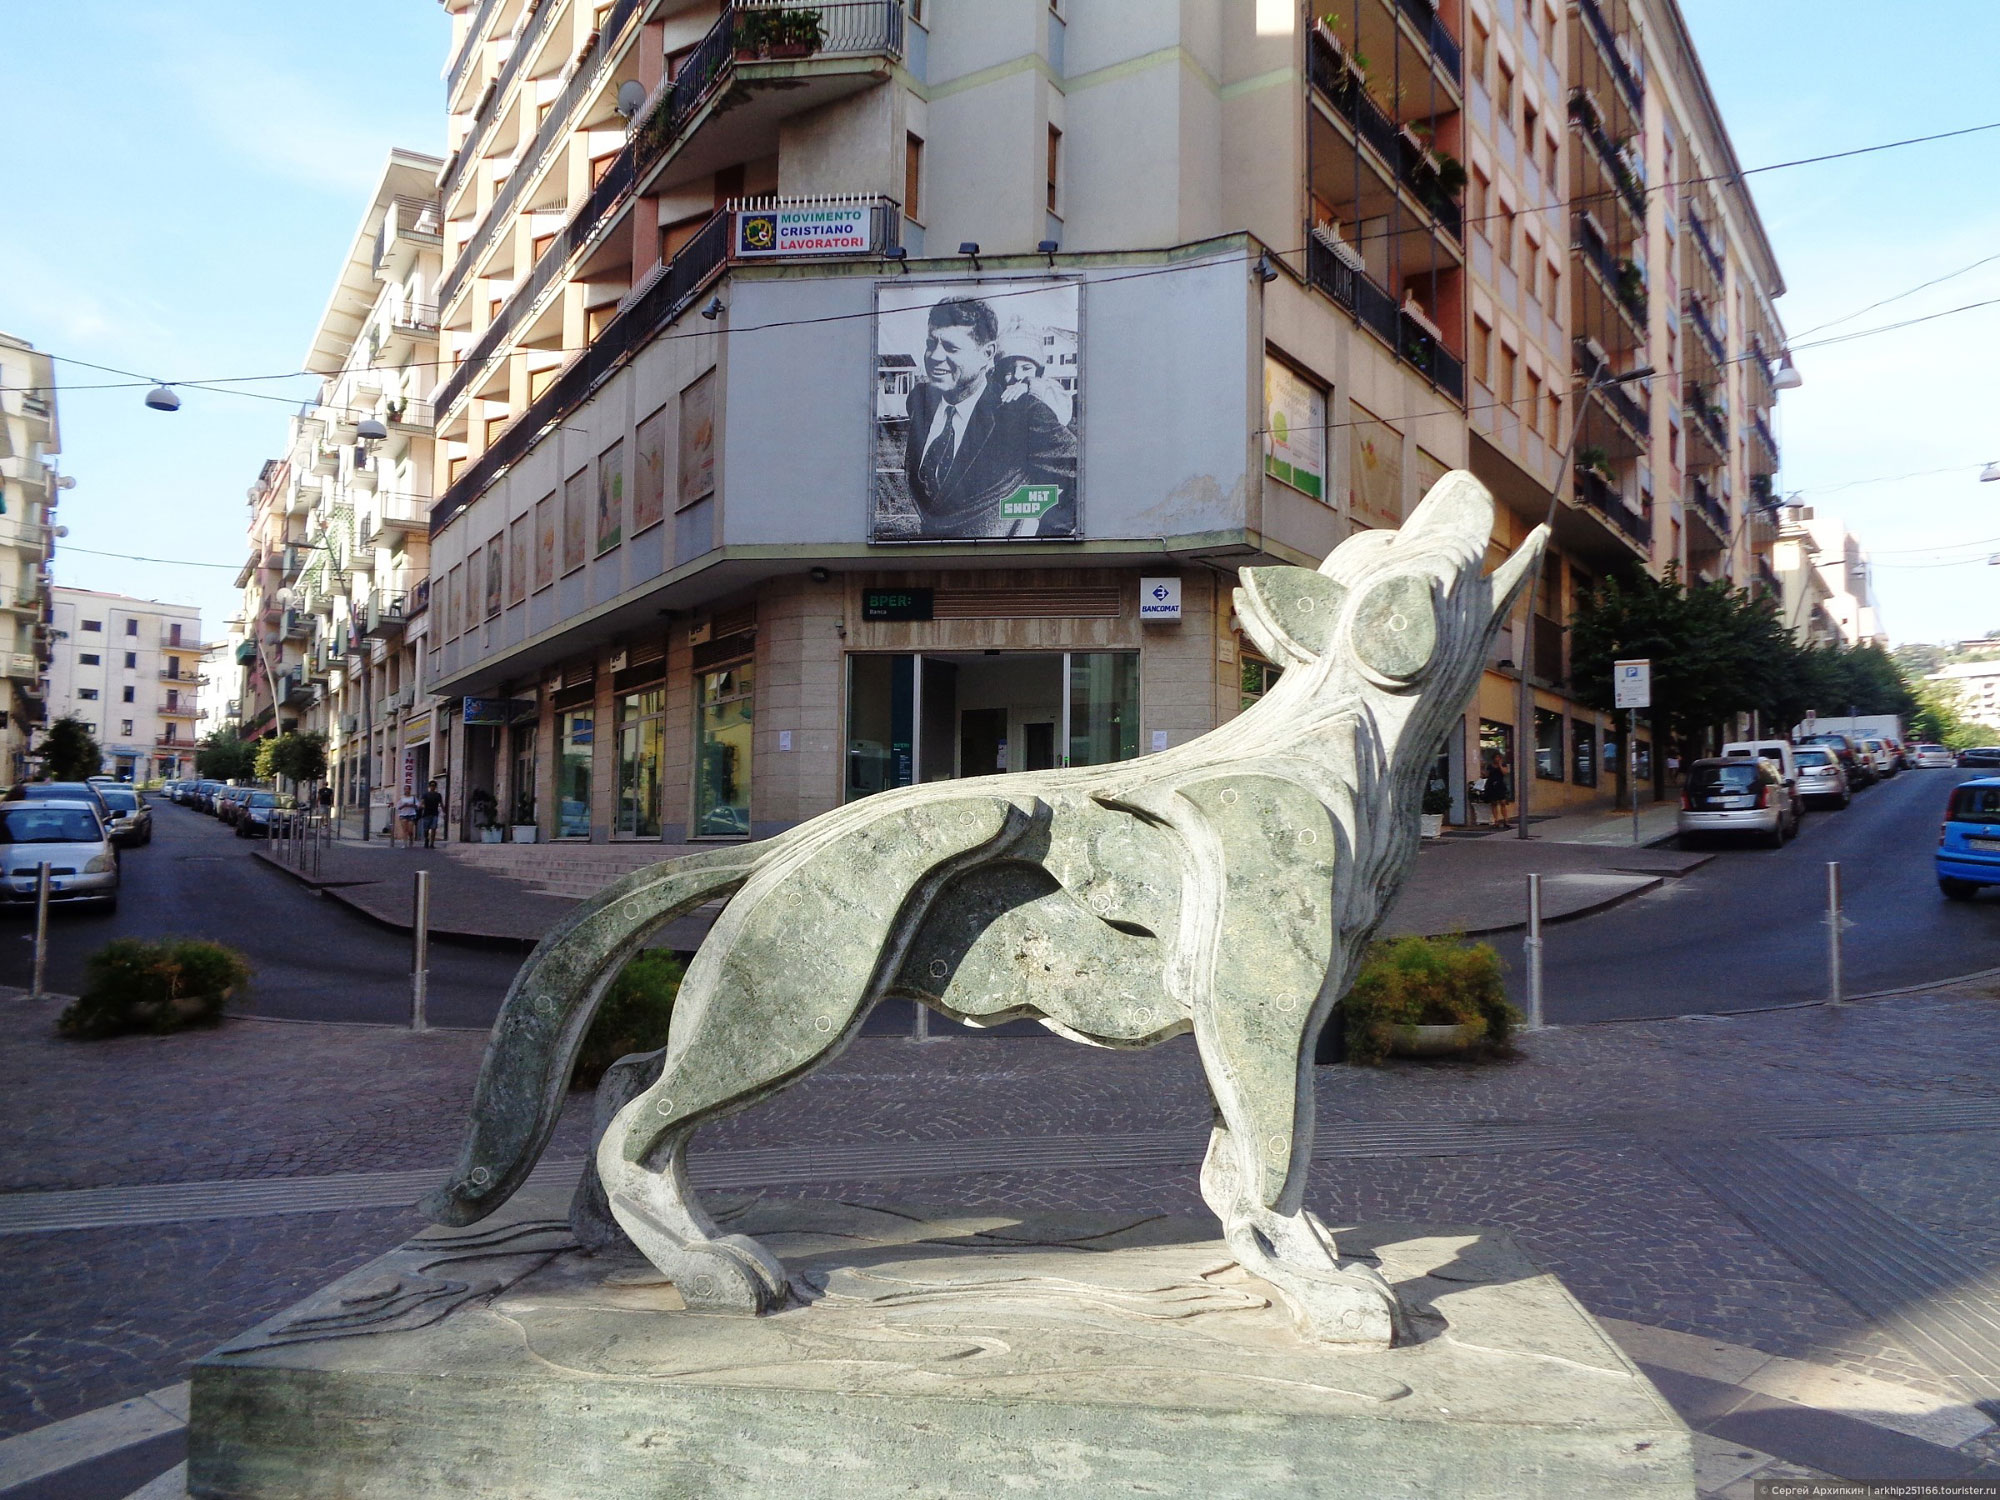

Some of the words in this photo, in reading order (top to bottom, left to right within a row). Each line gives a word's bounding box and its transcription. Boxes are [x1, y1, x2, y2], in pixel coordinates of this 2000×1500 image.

[781, 211, 861, 223] MOVIMENTO
[780, 225, 853, 236] CRISTIANO
[780, 237, 864, 250] LAVORATORI
[1004, 503, 1041, 514] SHOP
[1141, 605, 1180, 613] BANCOMAT
